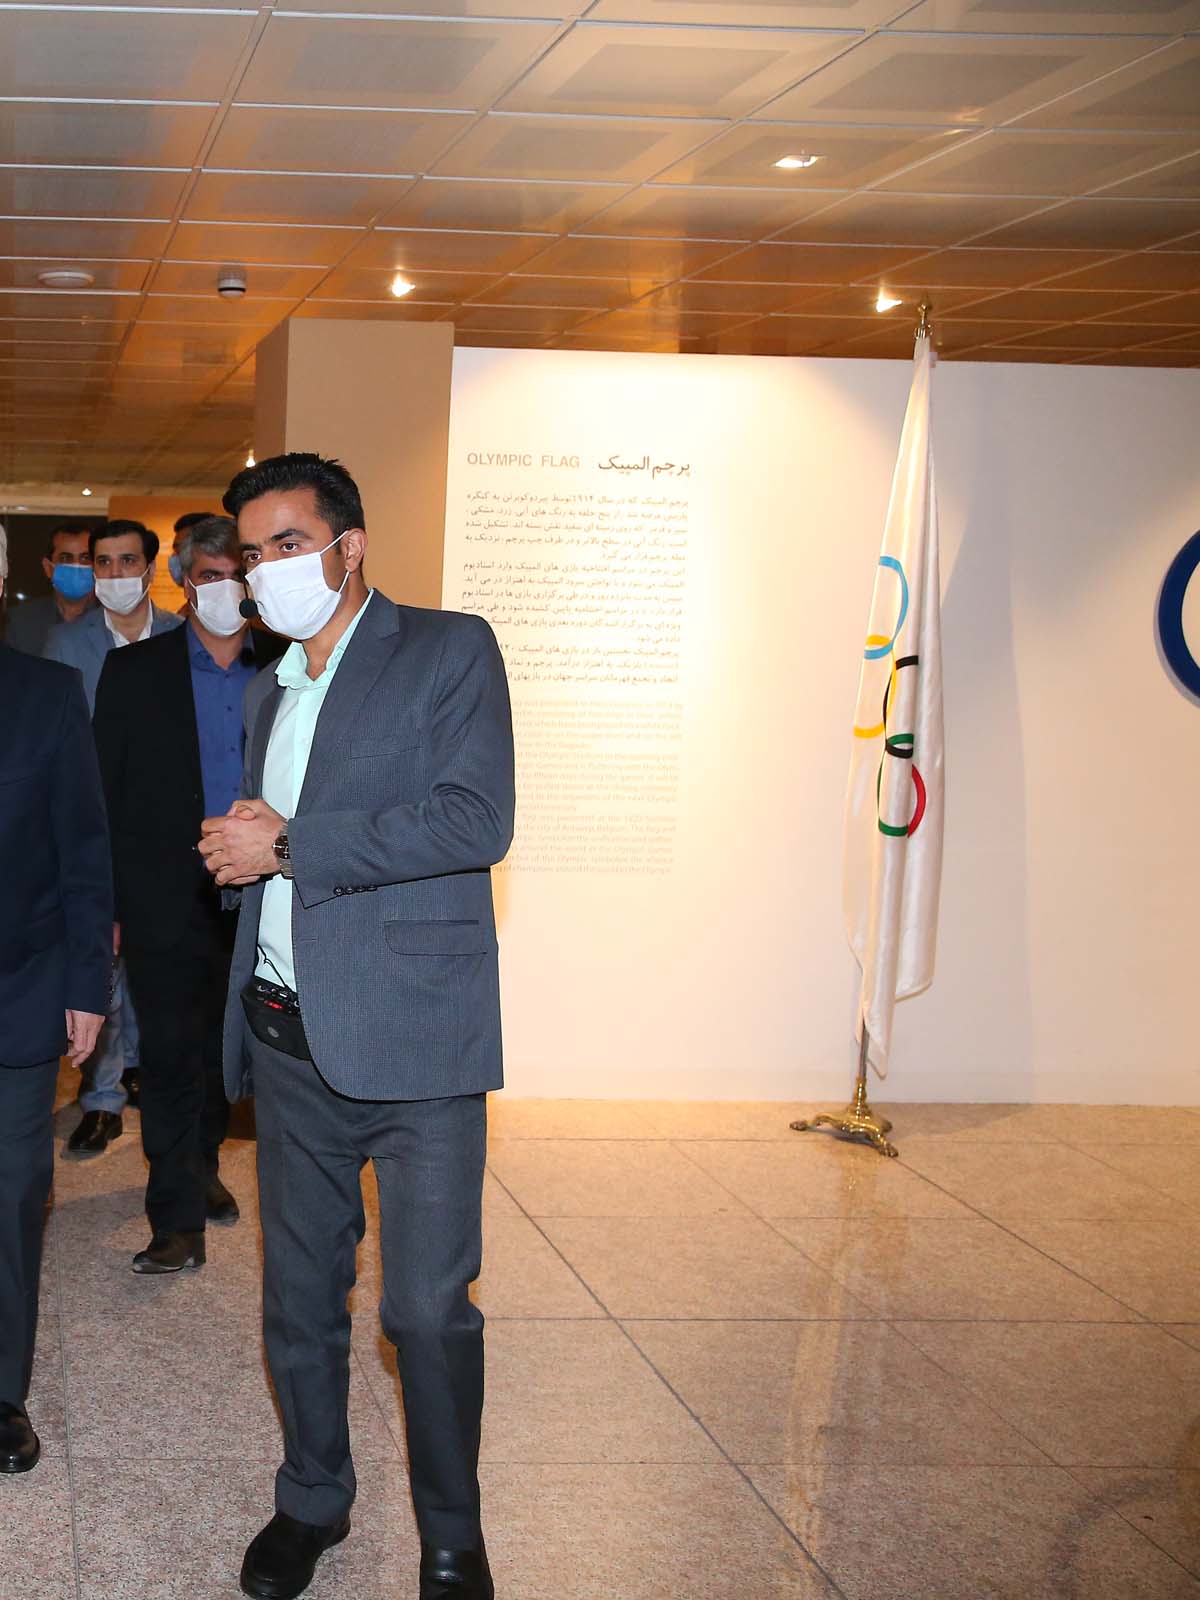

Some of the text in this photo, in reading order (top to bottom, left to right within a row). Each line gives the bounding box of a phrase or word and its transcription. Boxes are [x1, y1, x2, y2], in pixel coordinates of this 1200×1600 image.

[467, 452, 580, 468] OLYMPIC FLAG
[598, 455, 690, 480] پرچم المپیک
